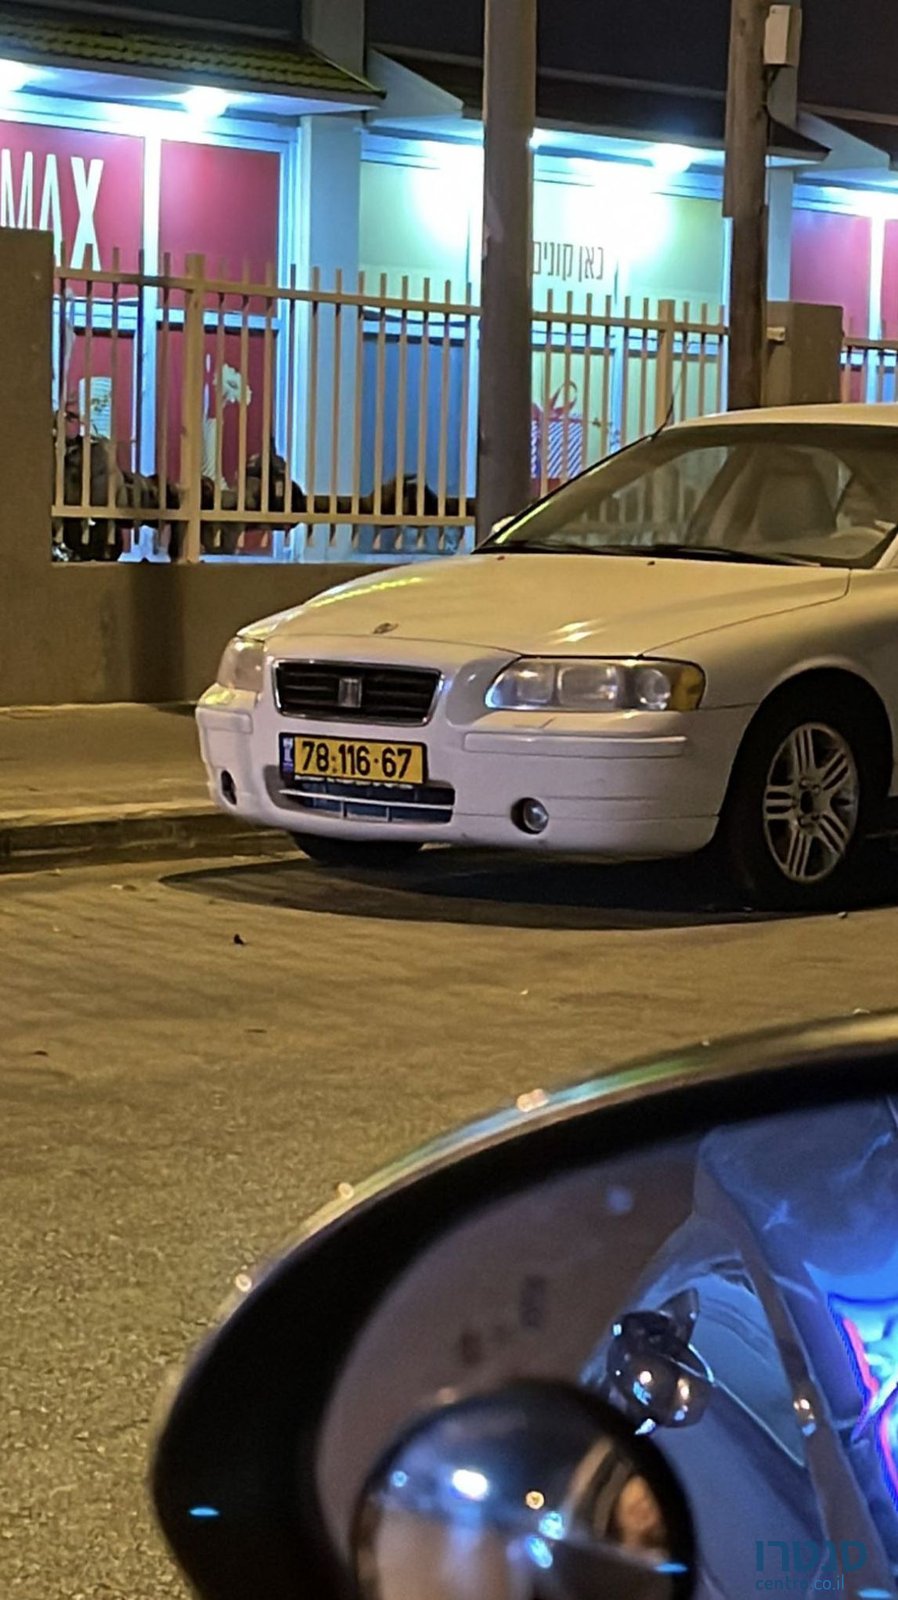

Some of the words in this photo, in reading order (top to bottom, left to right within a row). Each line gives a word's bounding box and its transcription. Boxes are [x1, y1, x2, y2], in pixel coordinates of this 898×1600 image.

[0, 148, 104, 272] MAX
[532, 240, 573, 282] קונים
[578, 245, 604, 283] כאן
